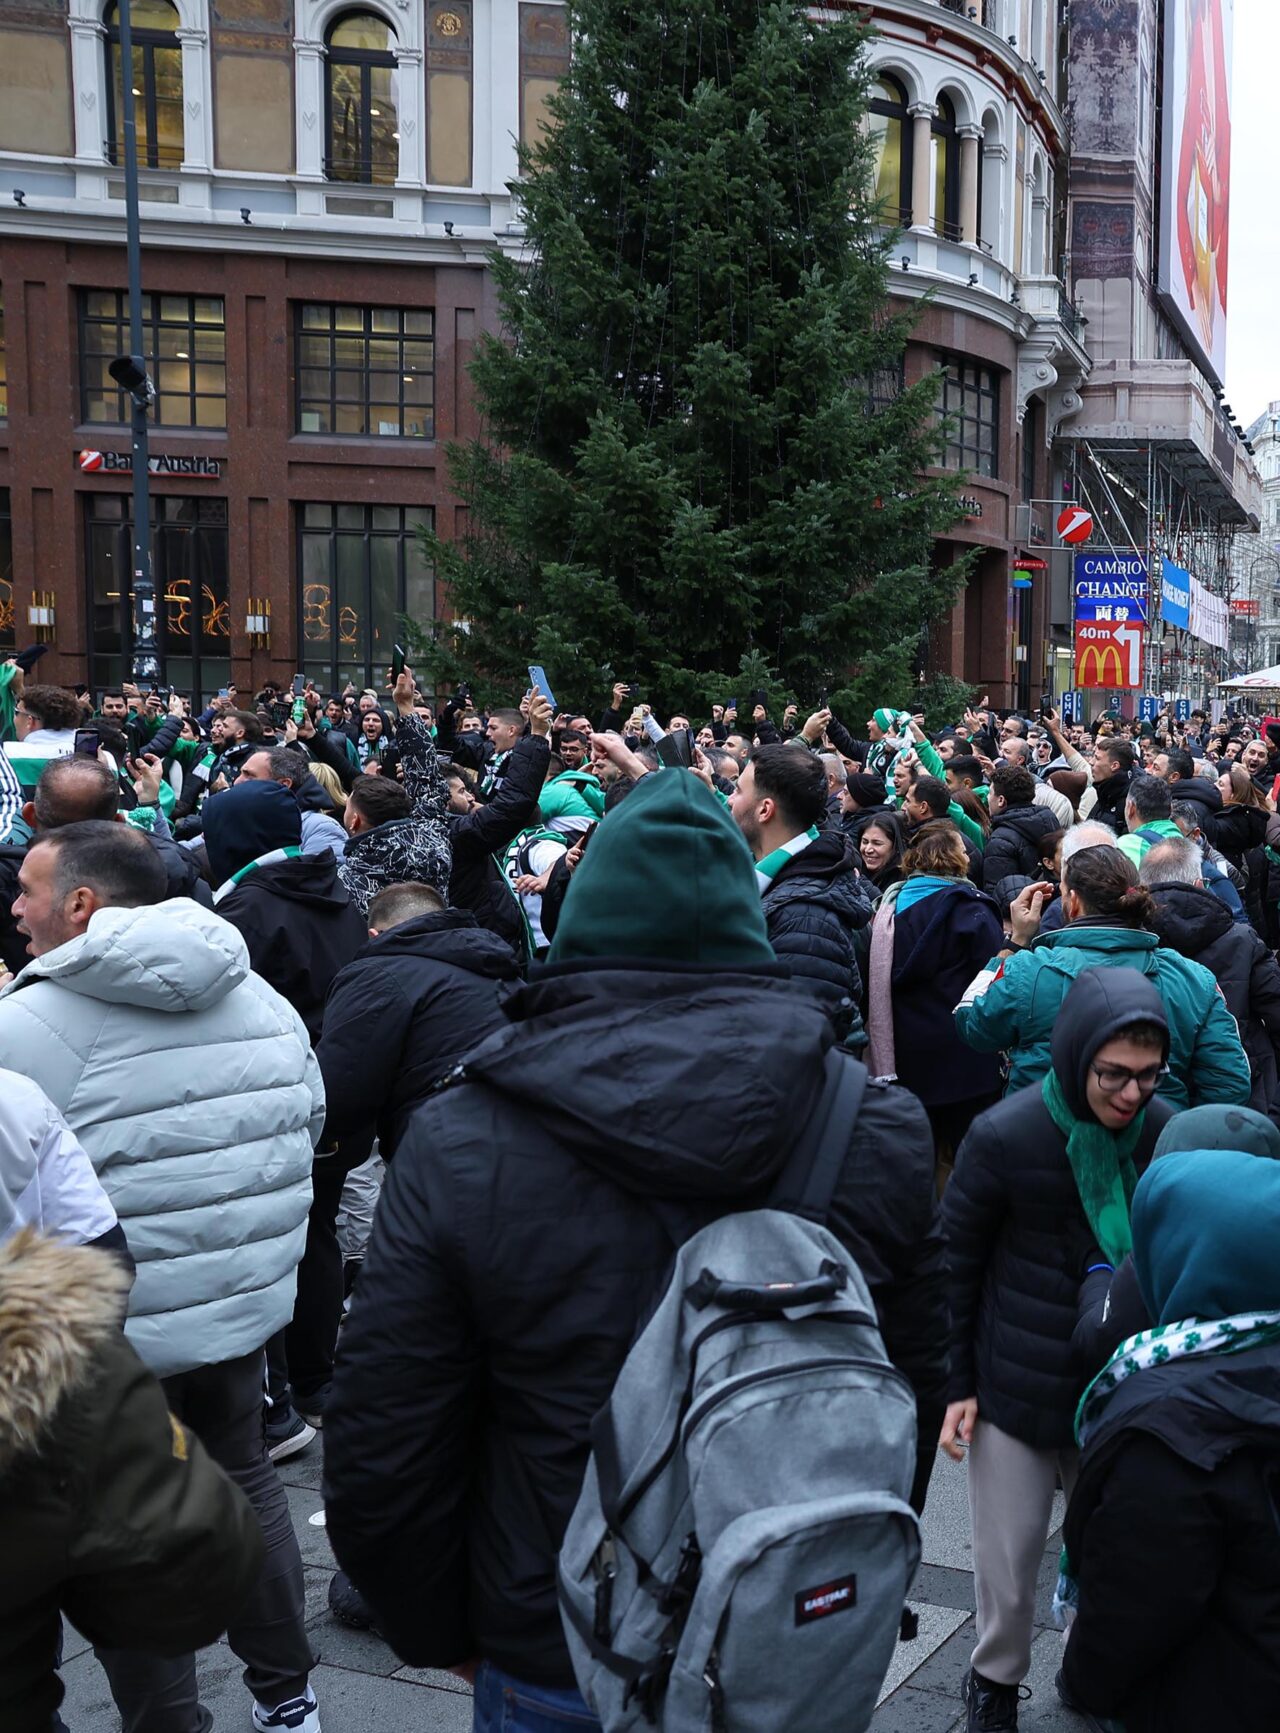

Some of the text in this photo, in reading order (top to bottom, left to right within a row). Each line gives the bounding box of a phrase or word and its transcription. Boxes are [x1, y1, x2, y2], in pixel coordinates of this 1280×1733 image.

[156, 454, 219, 475] Austria
[1084, 560, 1142, 575] CAMBIO
[1079, 627, 1111, 639] 40m
[804, 1587, 850, 1612] EASTPAK
[280, 1705, 305, 1718] Reebok
